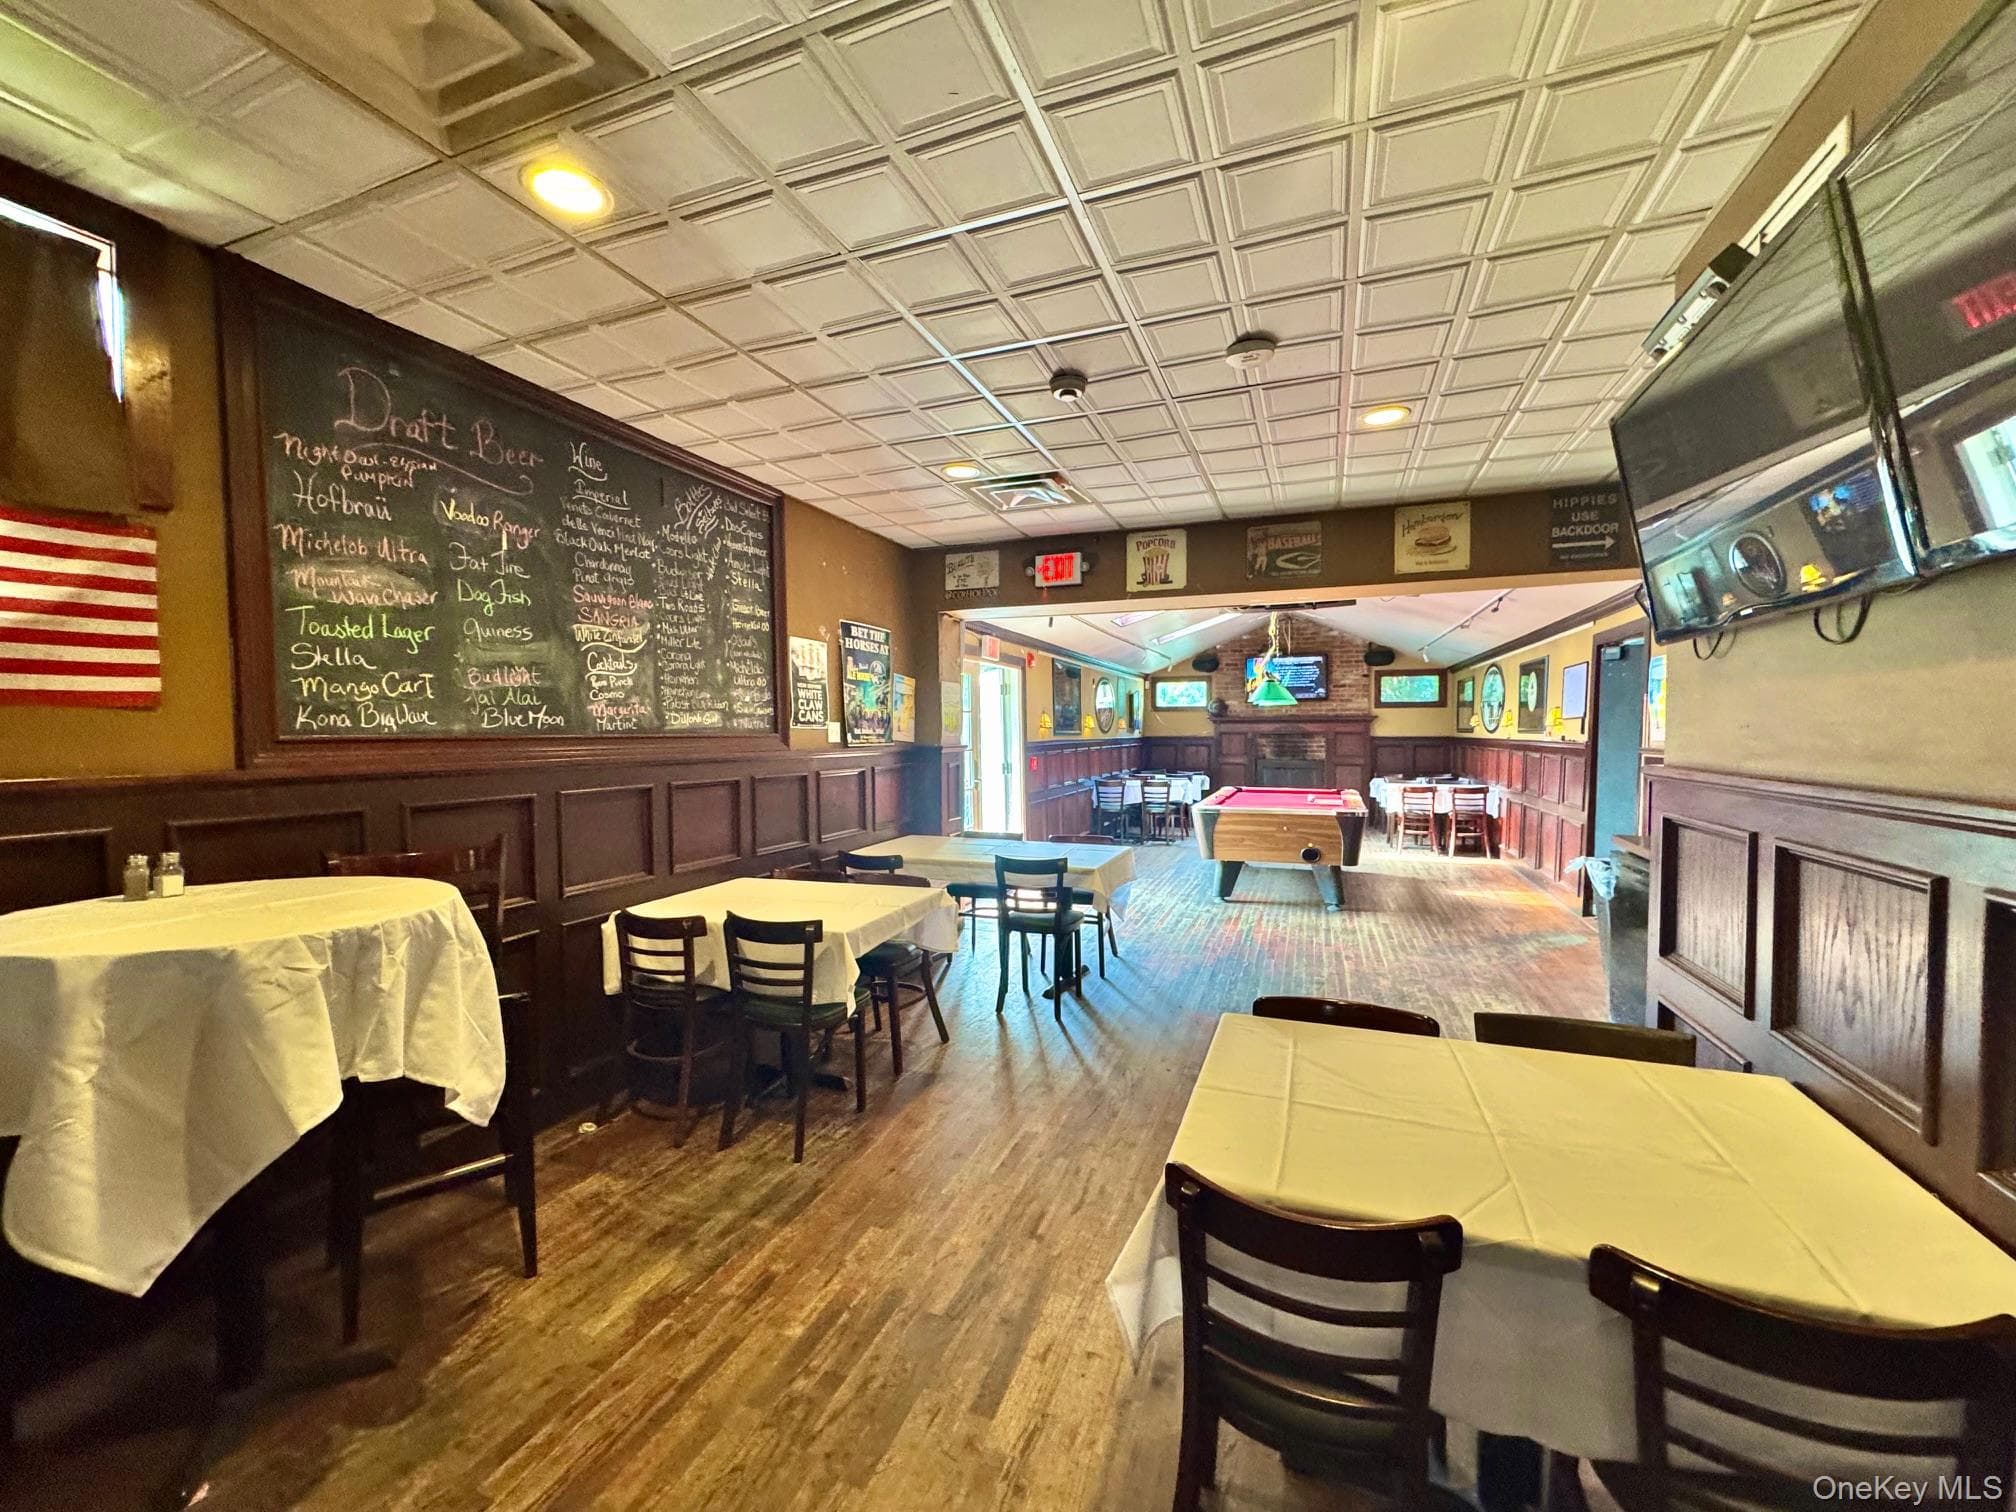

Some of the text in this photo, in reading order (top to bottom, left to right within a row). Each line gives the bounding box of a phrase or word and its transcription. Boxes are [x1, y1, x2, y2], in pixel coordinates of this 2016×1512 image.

[335, 367, 544, 466] Draft Beer
[273, 432, 340, 465] Night
[569, 441, 603, 472] Wine
[340, 464, 414, 492] Pumpkin
[1553, 493, 1617, 509] HIPPIES
[440, 498, 541, 550] Voodoo Ranger
[1571, 511, 1599, 522] USE
[1552, 522, 1619, 538] BACKDOOR
[273, 523, 430, 566] Michelob Ultra
[448, 541, 531, 578] Fat Tire
[458, 578, 531, 617] Dog Fish
[285, 605, 435, 655] Toasted Lager
[850, 625, 886, 643] BET THE
[291, 642, 377, 670] Stella
[844, 637, 890, 656] HORSES AT
[587, 651, 634, 673] Cocktails
[291, 676, 379, 702] Mango
[589, 689, 625, 700] Cosmo
[797, 688, 823, 700] WHITE
[296, 704, 351, 730] Kona
[358, 701, 395, 733] Big
[481, 704, 564, 730] Blue Moon
[798, 698, 824, 711] CLAW
[798, 709, 825, 723] CANS
